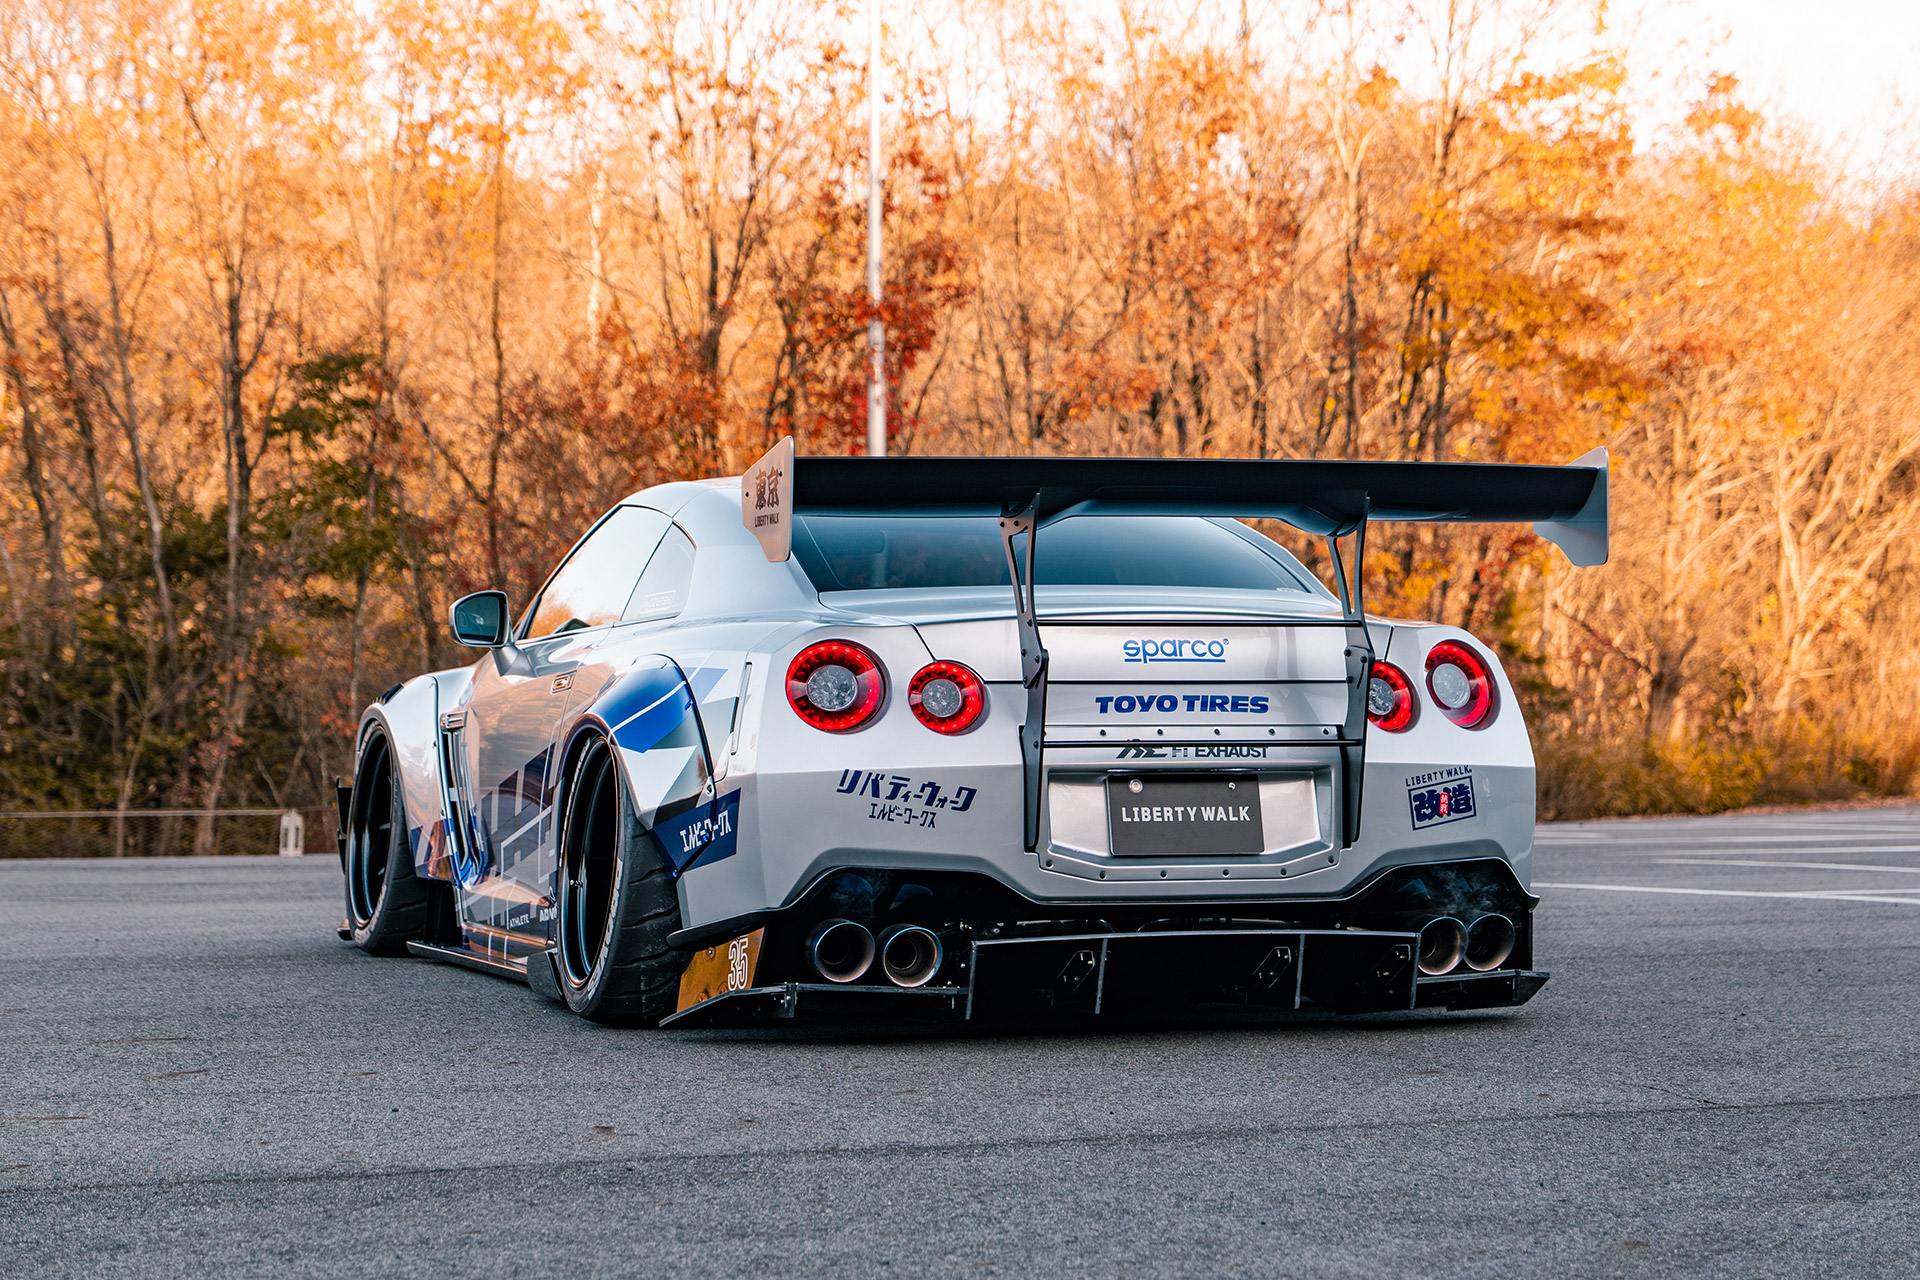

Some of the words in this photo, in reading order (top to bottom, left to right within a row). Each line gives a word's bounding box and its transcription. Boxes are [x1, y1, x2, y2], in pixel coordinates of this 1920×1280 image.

[755, 466, 780, 510] 東京
[754, 514, 769, 528] LIBERTY
[769, 512, 779, 525] WALK
[1095, 695, 1178, 714] TOYO
[1182, 694, 1269, 714] TIRES
[1194, 745, 1269, 759] EXHAUST
[1405, 769, 1445, 787] LIBERTY
[836, 768, 978, 812] リバティーウォーク
[868, 802, 937, 829] エルビーワークス
[1121, 806, 1198, 822] LIBERTY
[1200, 806, 1251, 822] WALK
[509, 913, 530, 929] ATHLETE
[727, 936, 749, 991] 35
